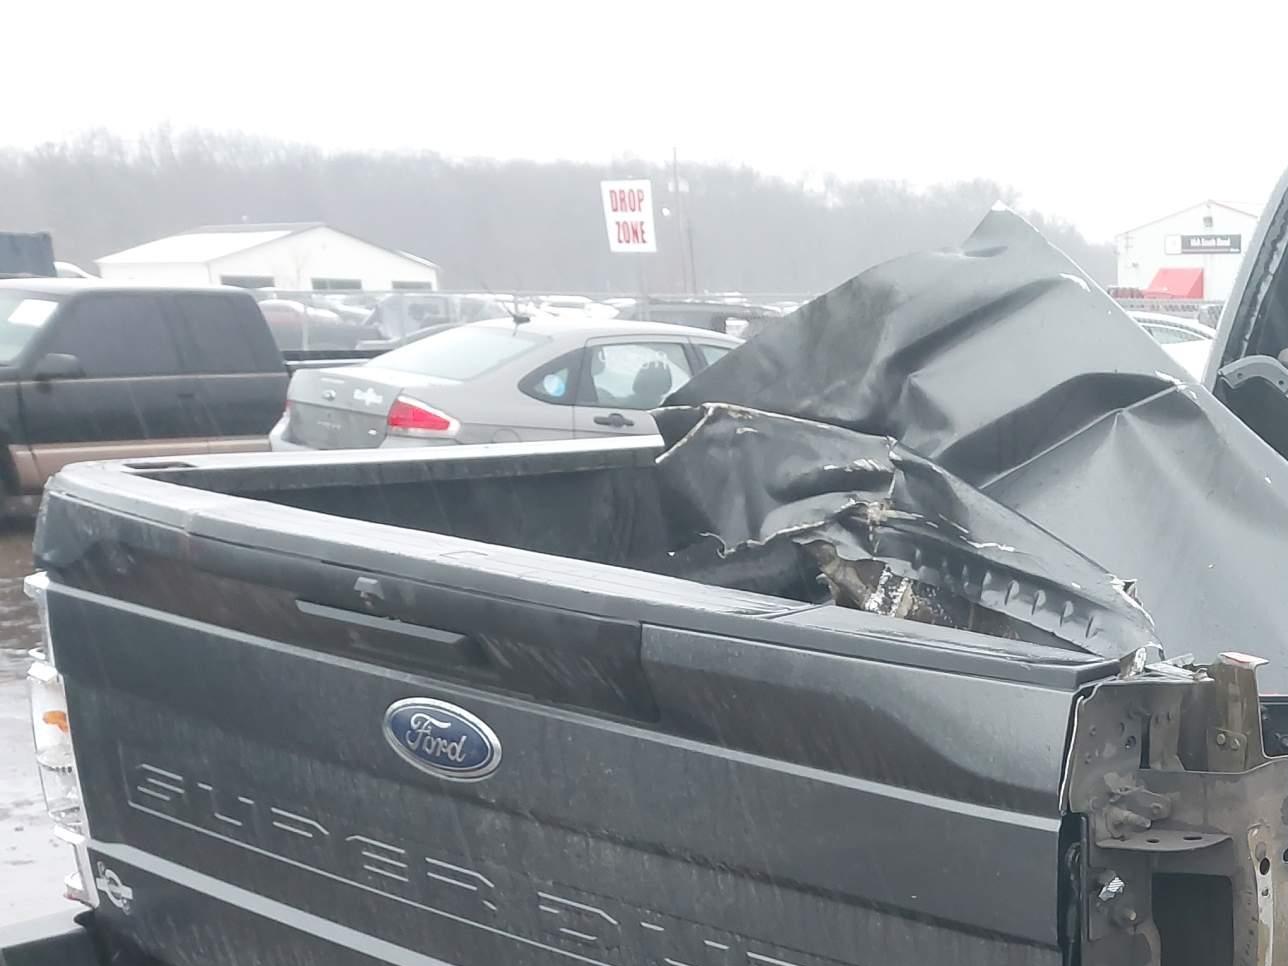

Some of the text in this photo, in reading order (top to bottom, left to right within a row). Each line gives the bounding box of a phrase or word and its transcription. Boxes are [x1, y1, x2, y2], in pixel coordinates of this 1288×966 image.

[609, 188, 645, 212] DROP
[615, 220, 648, 244] ZONE
[405, 713, 467, 762] Ford
[136, 764, 497, 912] SUPER
